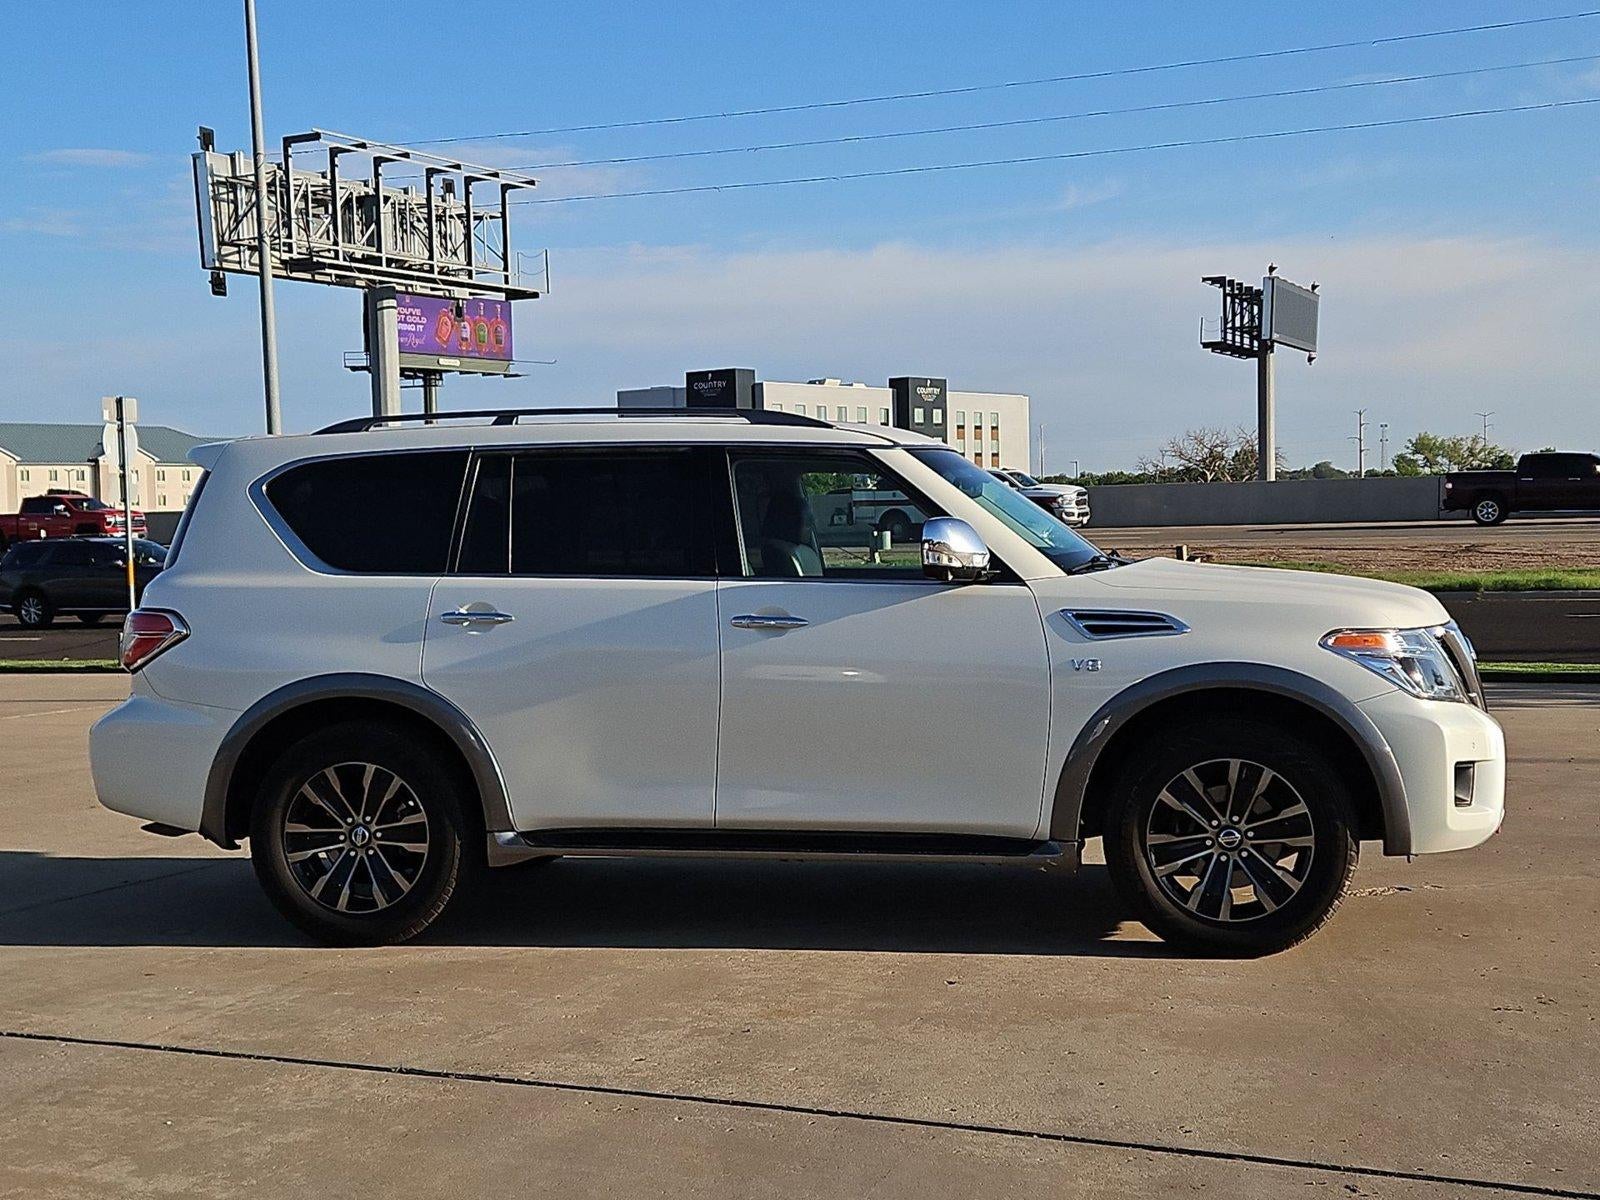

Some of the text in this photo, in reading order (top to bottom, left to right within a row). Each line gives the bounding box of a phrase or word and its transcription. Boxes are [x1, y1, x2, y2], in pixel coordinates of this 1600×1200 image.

[397, 314, 427, 324] OT GOLD
[398, 322, 424, 332] RING IT
[693, 380, 727, 390] COUNTRY
[1071, 658, 1102, 672] V8
